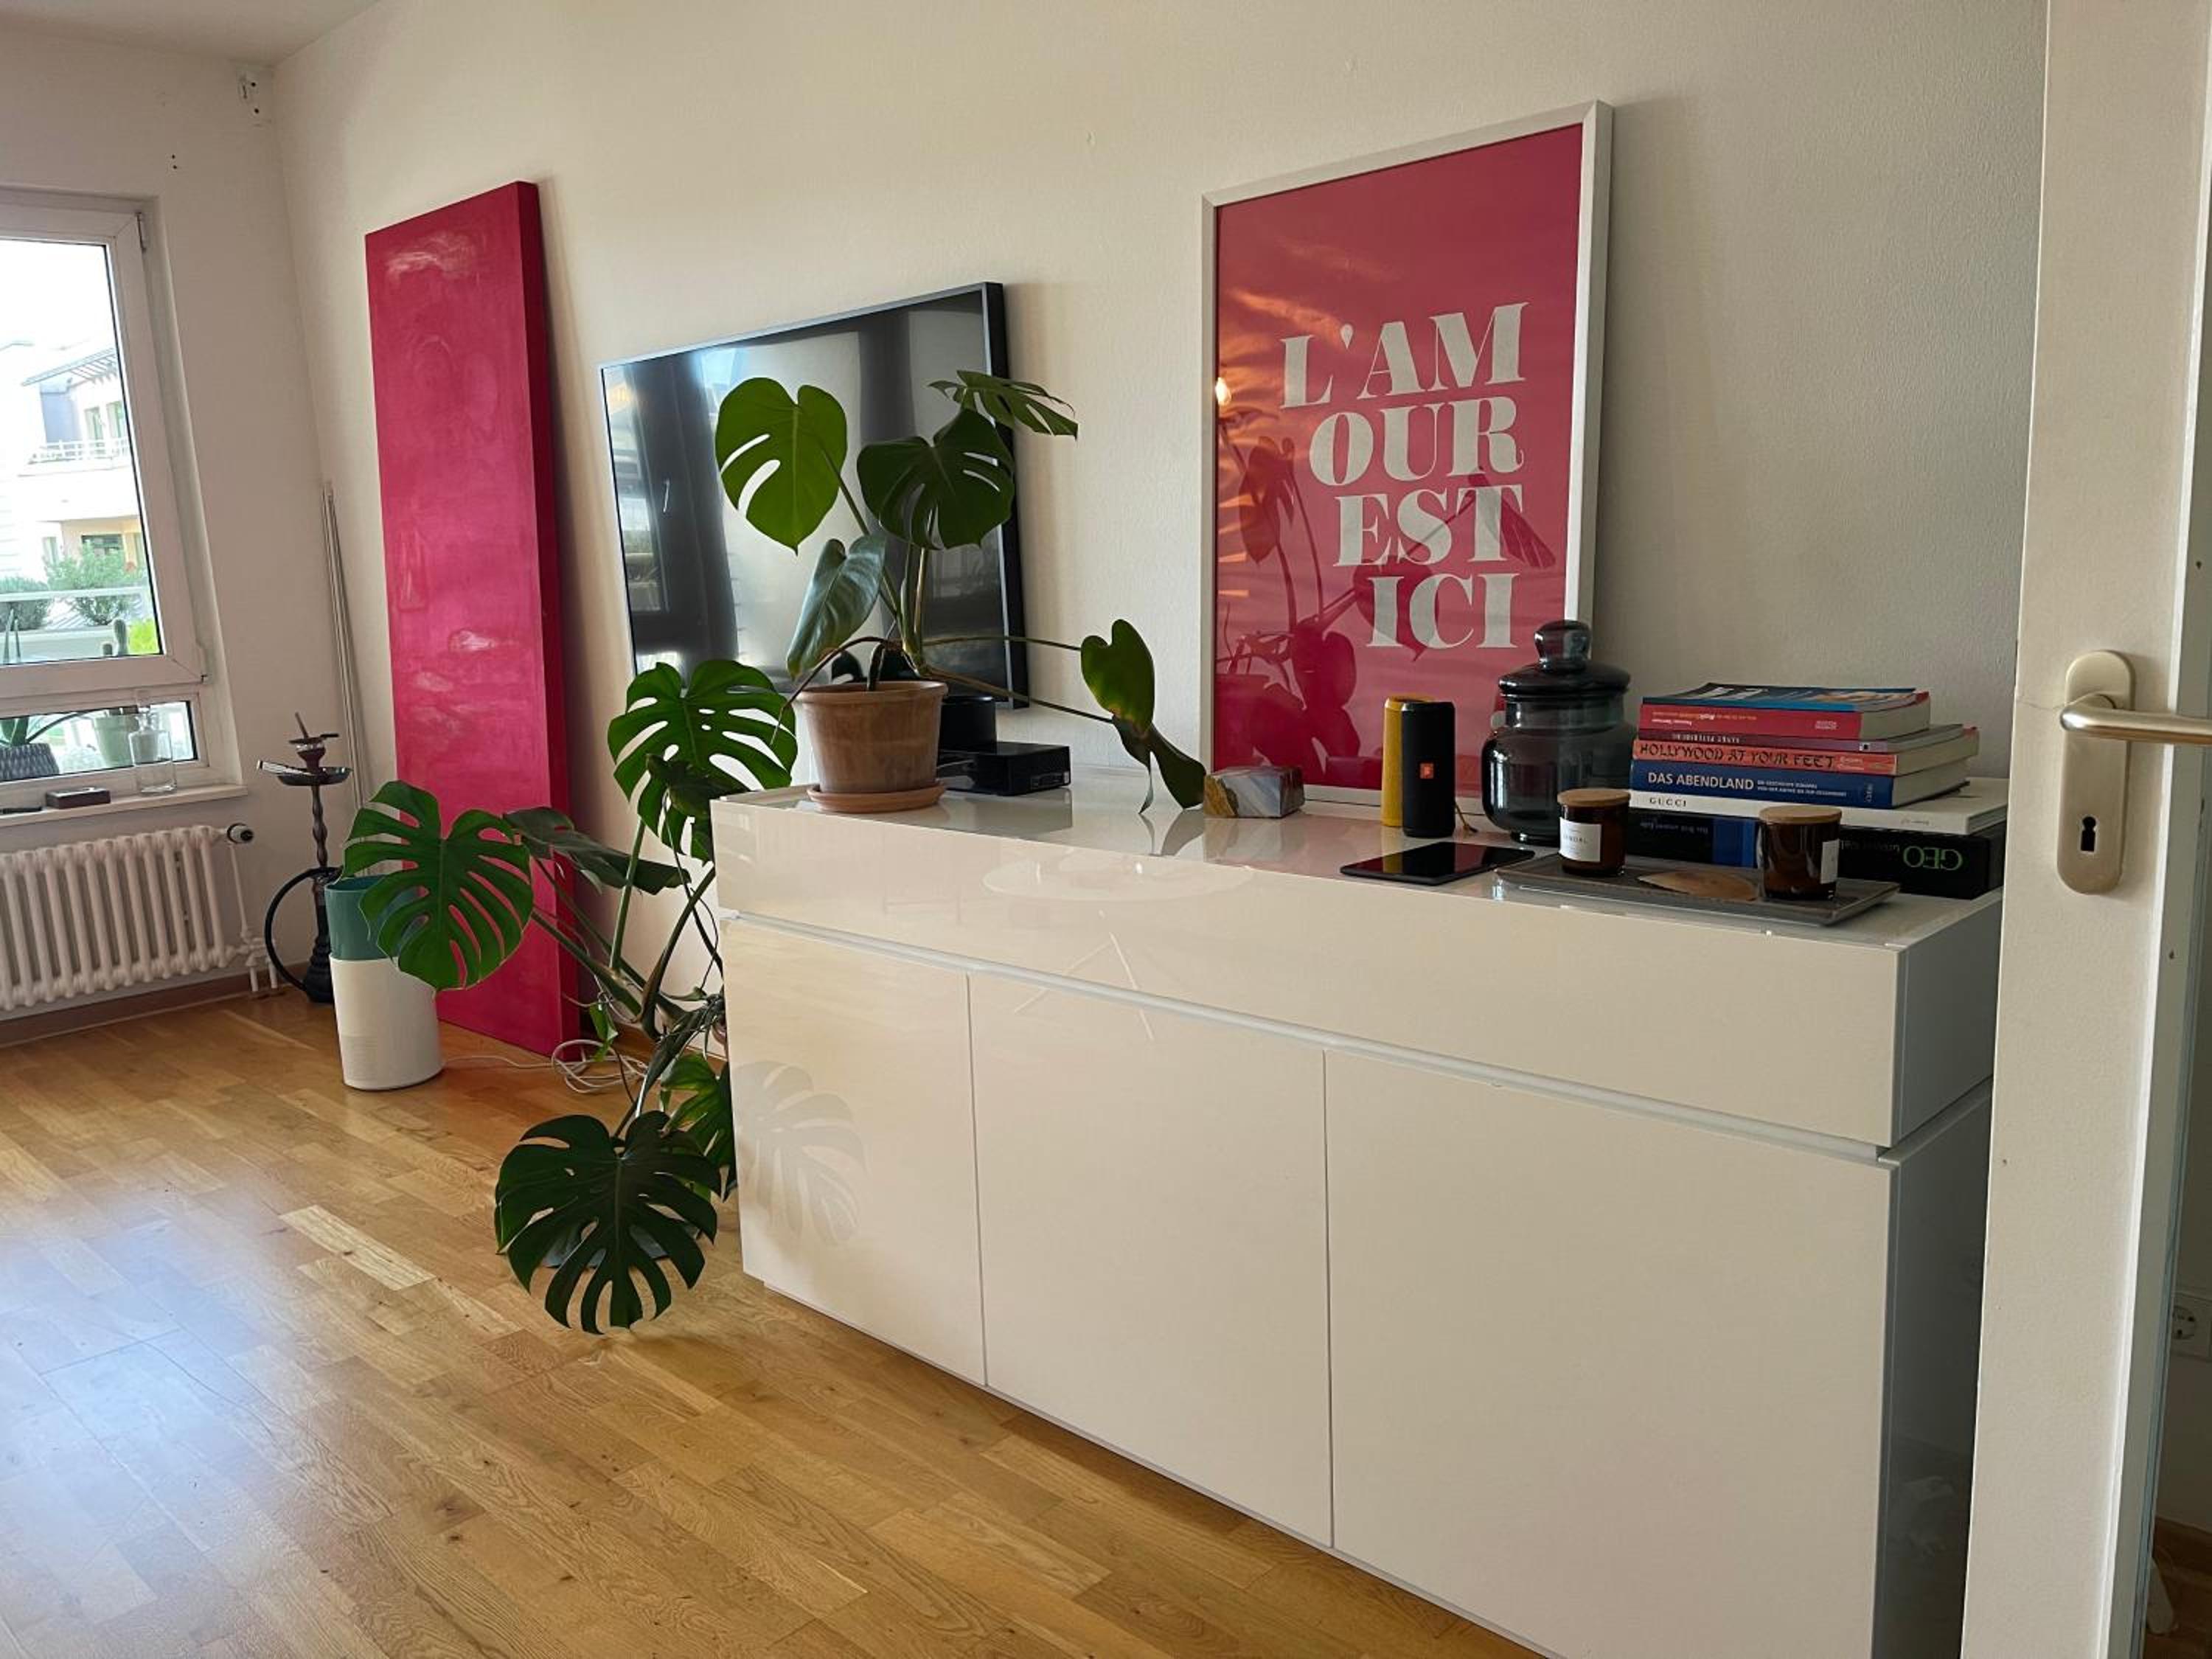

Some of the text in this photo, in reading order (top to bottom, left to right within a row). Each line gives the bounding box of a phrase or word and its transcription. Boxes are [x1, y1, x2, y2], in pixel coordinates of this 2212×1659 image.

[1281, 302, 1529, 410] L'AM
[1309, 396, 1523, 487] OUR
[1333, 484, 1523, 568] EST
[1366, 572, 1518, 650] ICI
[1639, 745, 1724, 761] HOLLYWOOD
[1728, 749, 1746, 762] AT
[1750, 751, 1788, 765] YOUR
[1792, 754, 1836, 768] FEET
[1648, 772, 1754, 790] DAS ABENDLAND
[1649, 796, 1687, 807] GUCCI
[1903, 846, 1963, 871] GEO
